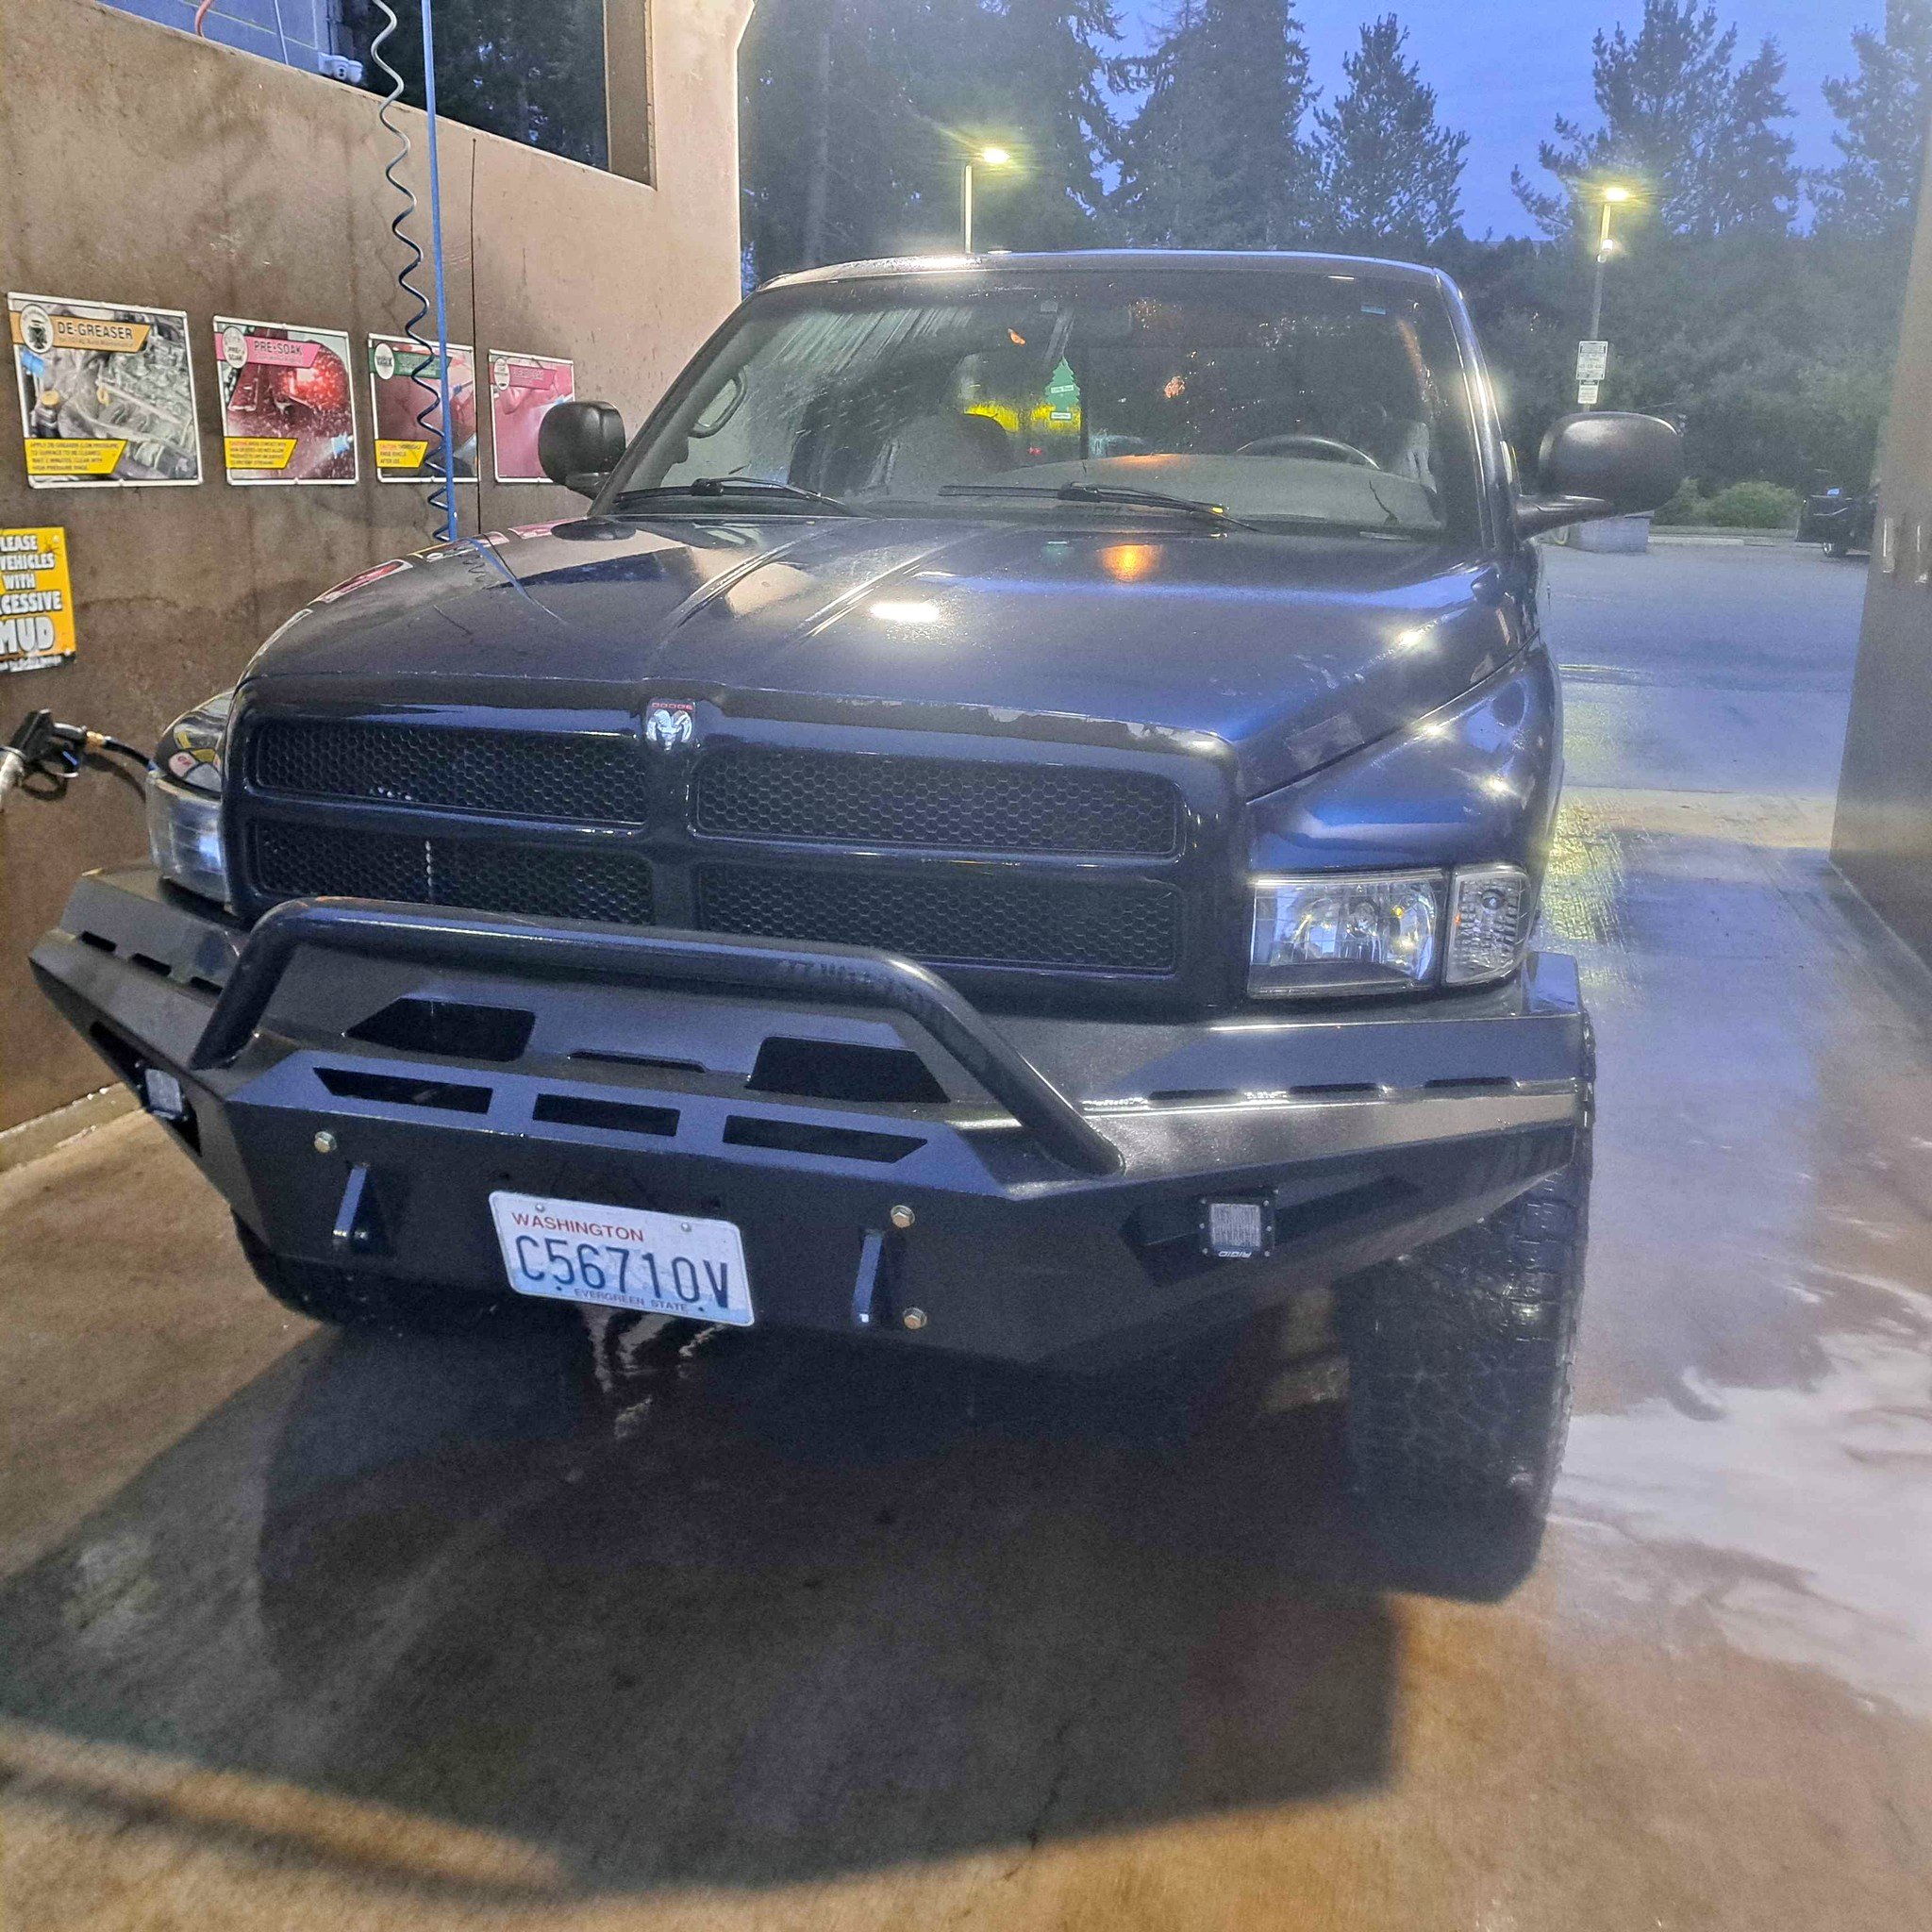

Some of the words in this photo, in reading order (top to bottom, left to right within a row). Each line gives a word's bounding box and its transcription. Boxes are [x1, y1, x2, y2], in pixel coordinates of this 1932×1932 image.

[58, 322, 133, 340] DE-GREASER
[0, 535, 38, 552] LEASE
[2, 573, 36, 591] WITH
[0, 591, 62, 615] CESSIVE
[0, 616, 55, 654] MUD
[511, 1212, 644, 1242] WASHINGTON
[516, 1235, 729, 1309] C56710V
[575, 1288, 645, 1307] EVERGREEN
[651, 1298, 689, 1312] STATE
